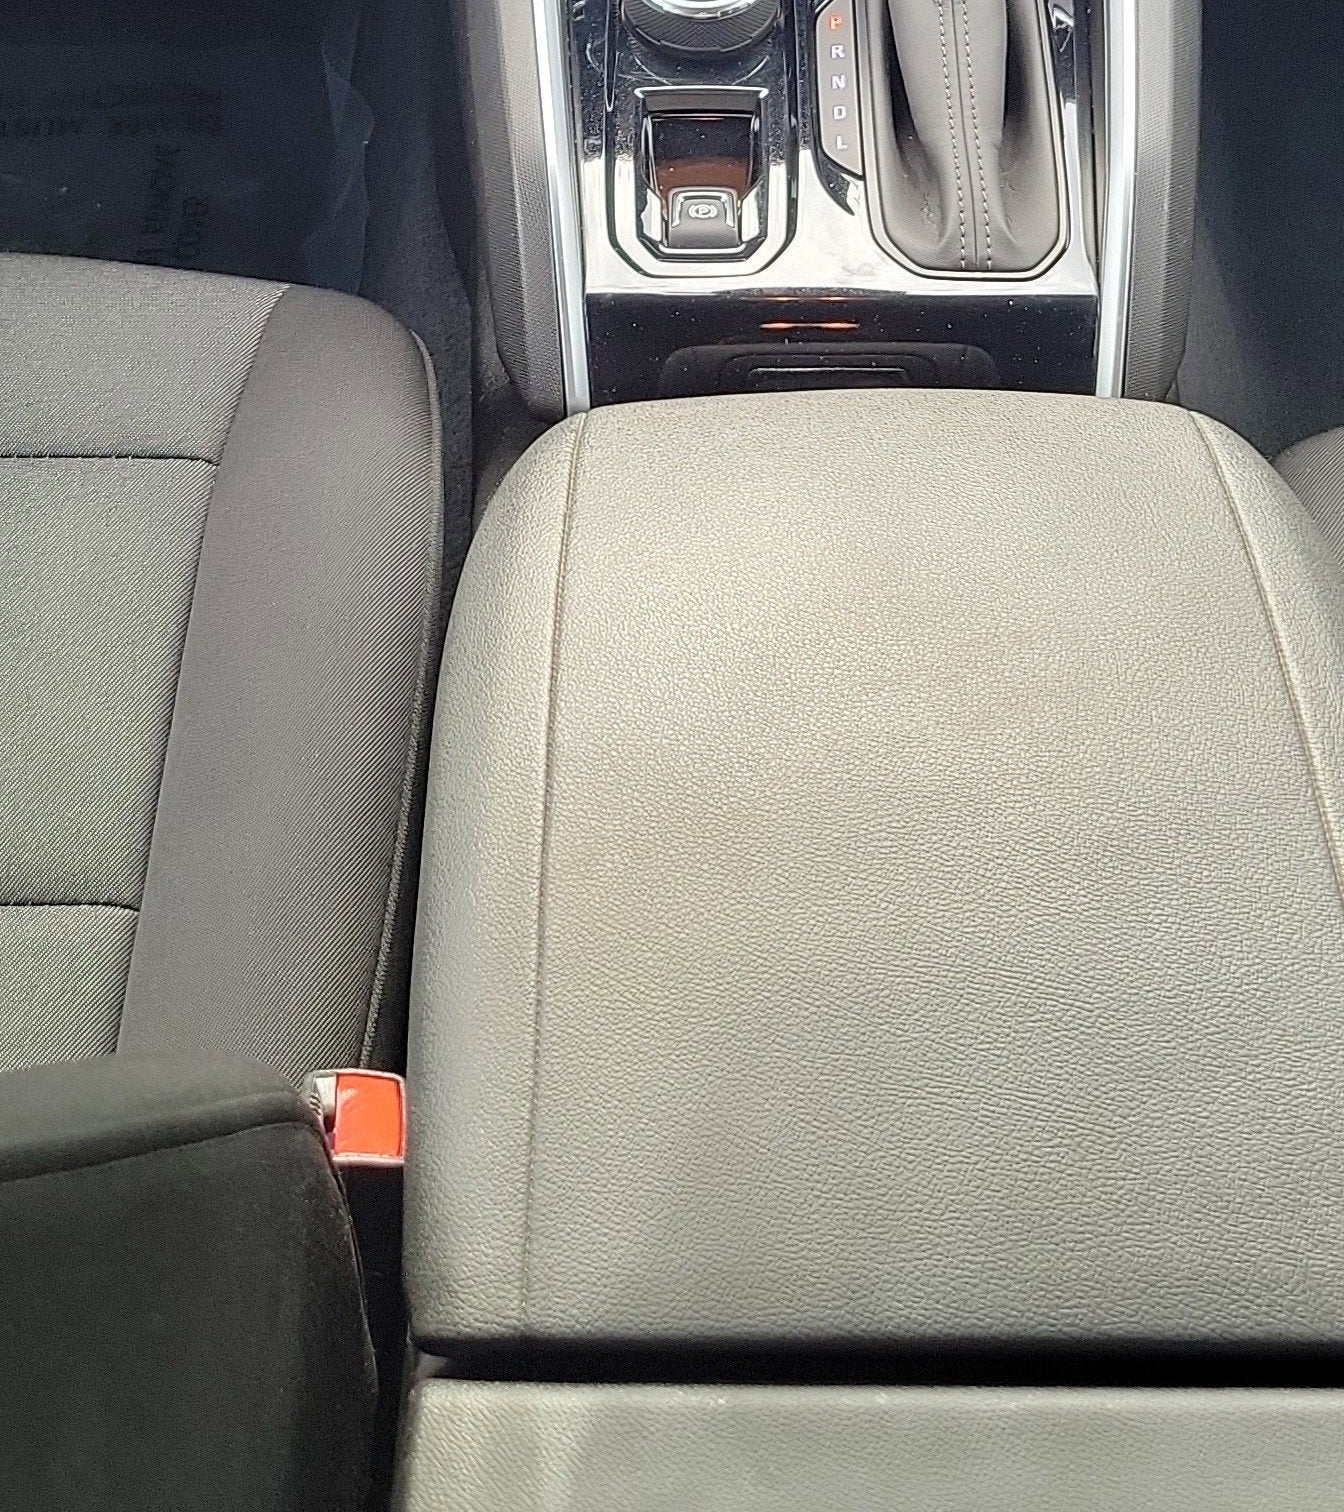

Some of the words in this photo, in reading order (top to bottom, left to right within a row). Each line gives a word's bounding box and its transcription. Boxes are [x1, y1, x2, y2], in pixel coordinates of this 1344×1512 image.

[830, 15, 843, 30] P
[830, 44, 845, 59] R
[831, 74, 846, 90] N
[833, 105, 847, 120] D
[836, 135, 847, 150] L
